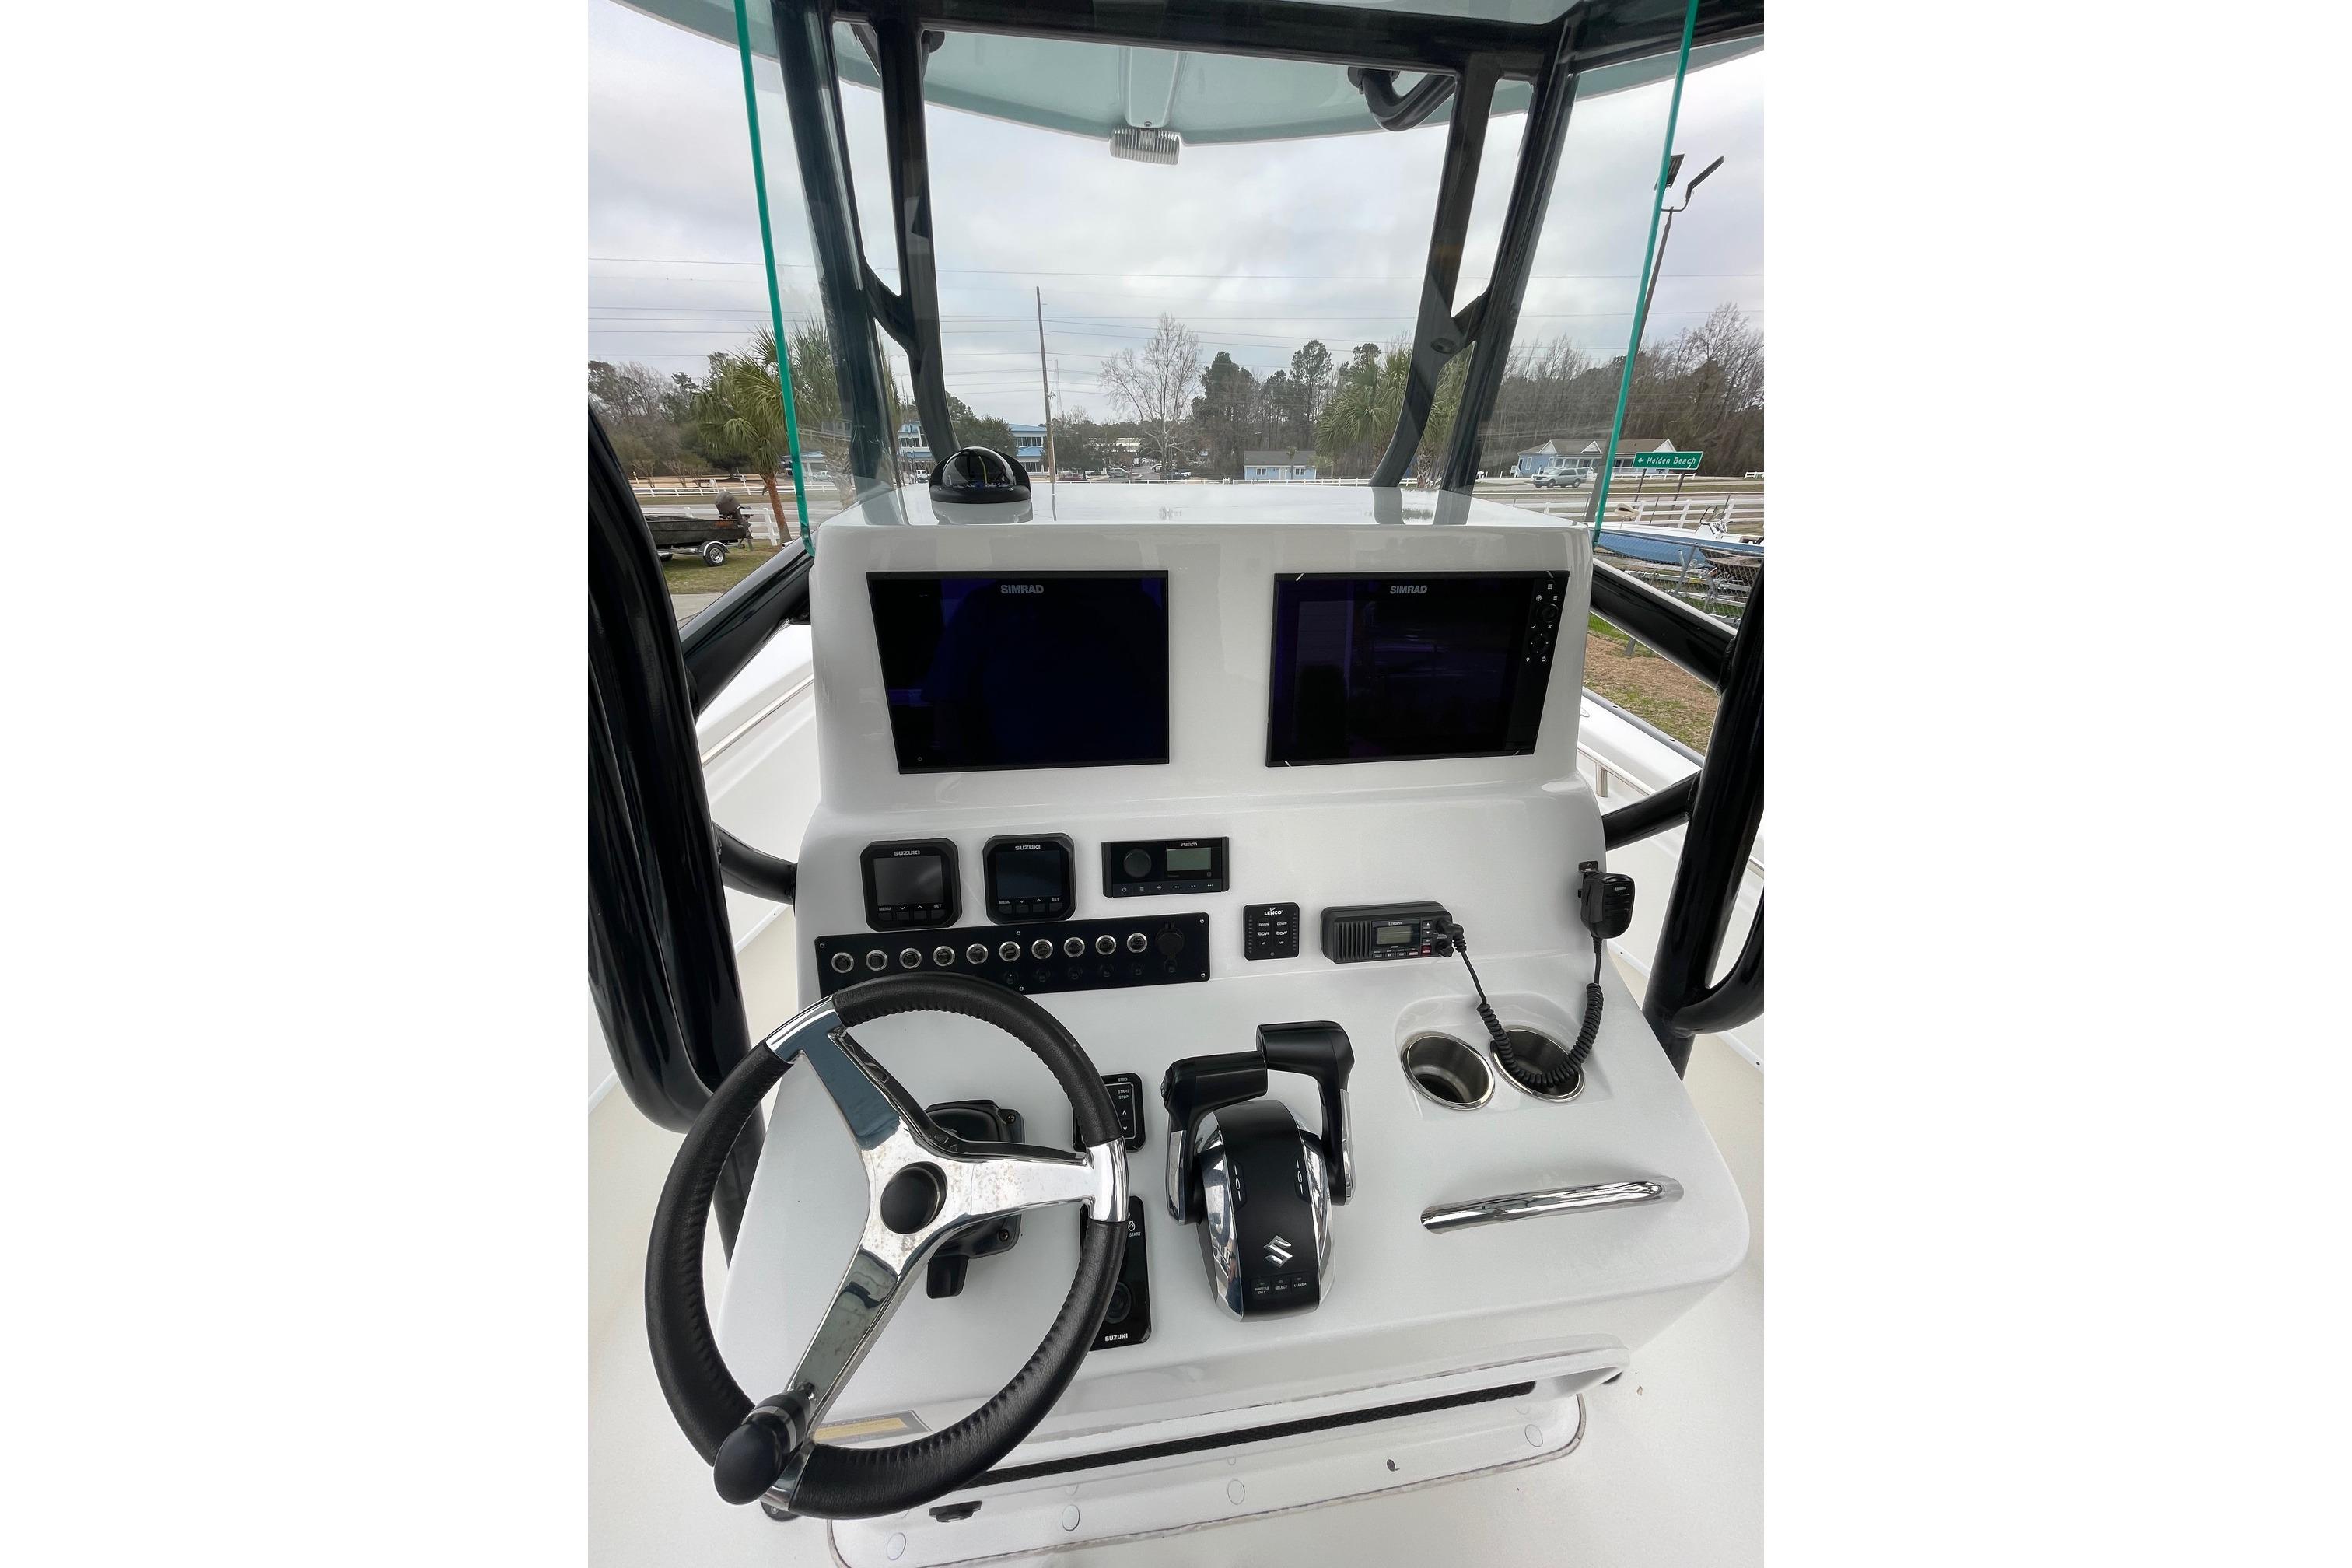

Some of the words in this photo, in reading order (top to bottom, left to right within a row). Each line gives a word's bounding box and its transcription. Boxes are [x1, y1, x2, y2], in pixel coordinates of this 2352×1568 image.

[1000, 585, 1045, 594] SIMRAD
[1390, 585, 1428, 594] SIMRAD
[1104, 1333, 1129, 1342] SUZUKI
